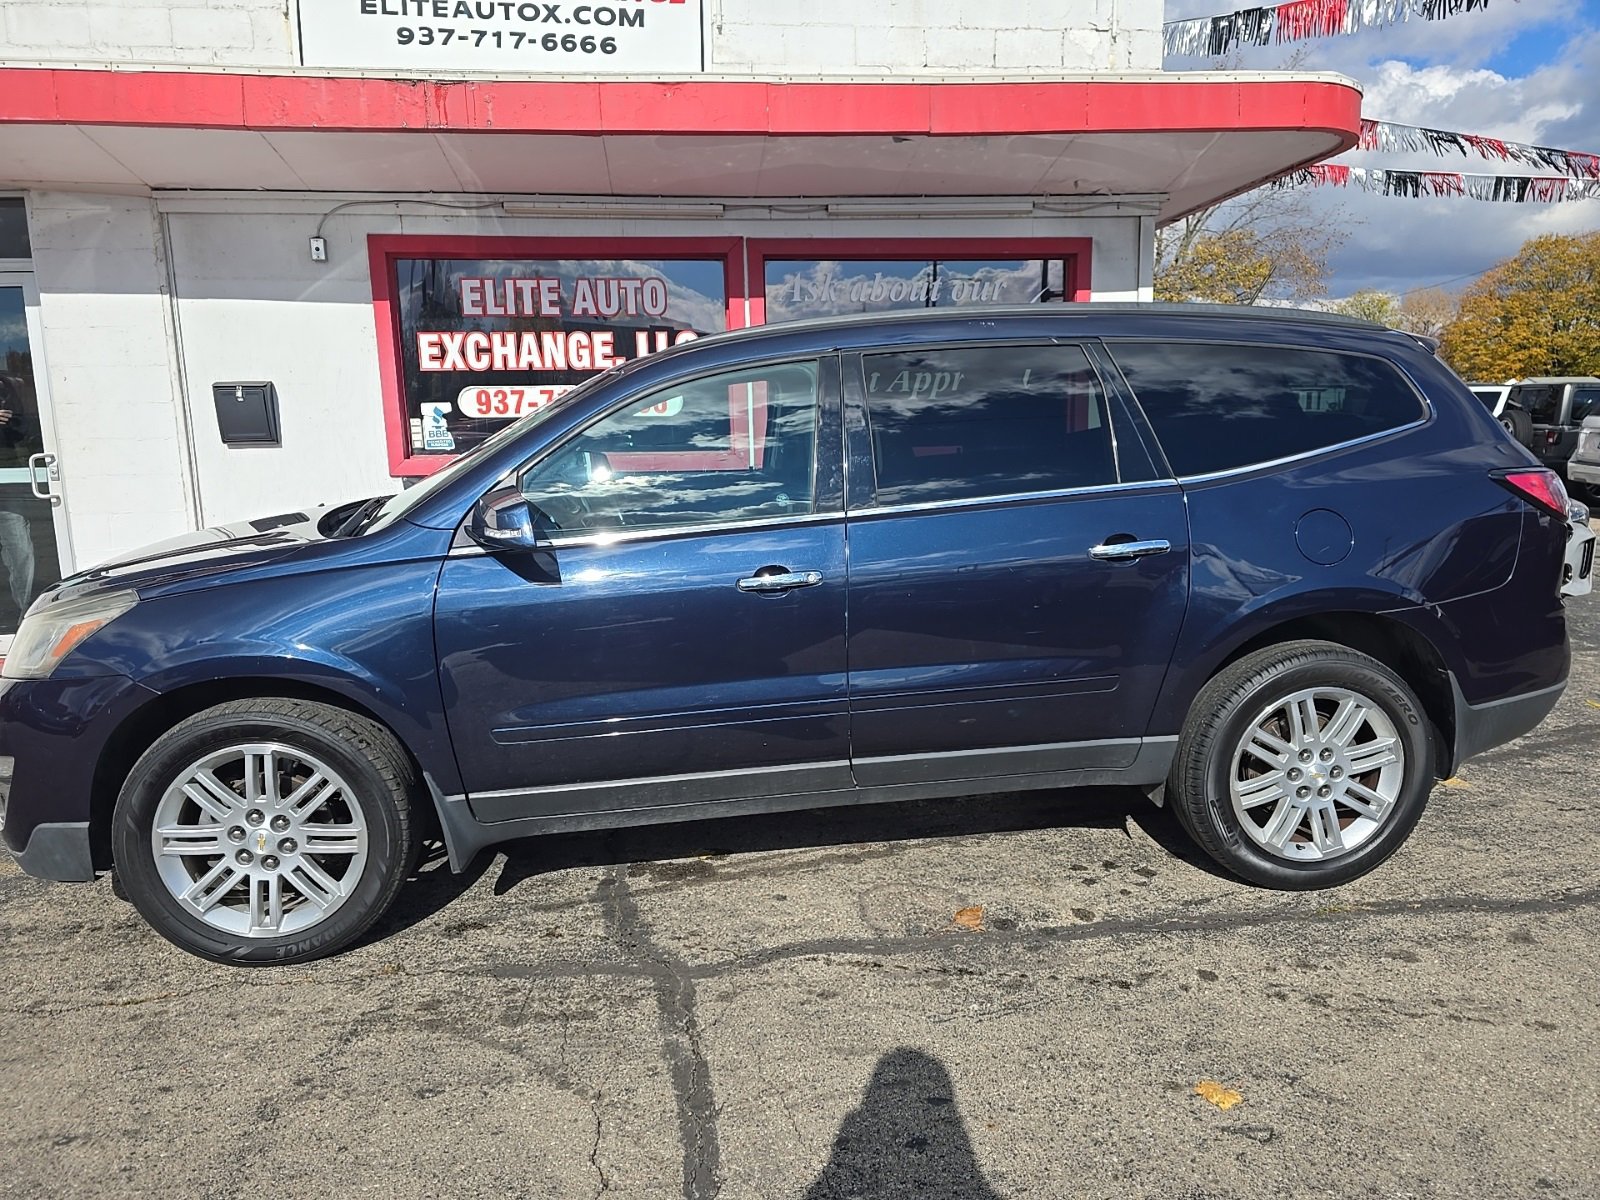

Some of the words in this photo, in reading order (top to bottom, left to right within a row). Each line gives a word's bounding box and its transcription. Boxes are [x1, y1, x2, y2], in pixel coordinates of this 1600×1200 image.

[360, 0, 645, 27] ELITEAUTOX.COM
[396, 26, 617, 54] 937-717-6666
[459, 277, 561, 317] ELITE
[572, 277, 668, 318] AUTO
[782, 271, 841, 302] Ask
[850, 272, 943, 302] about
[950, 278, 1008, 302] our
